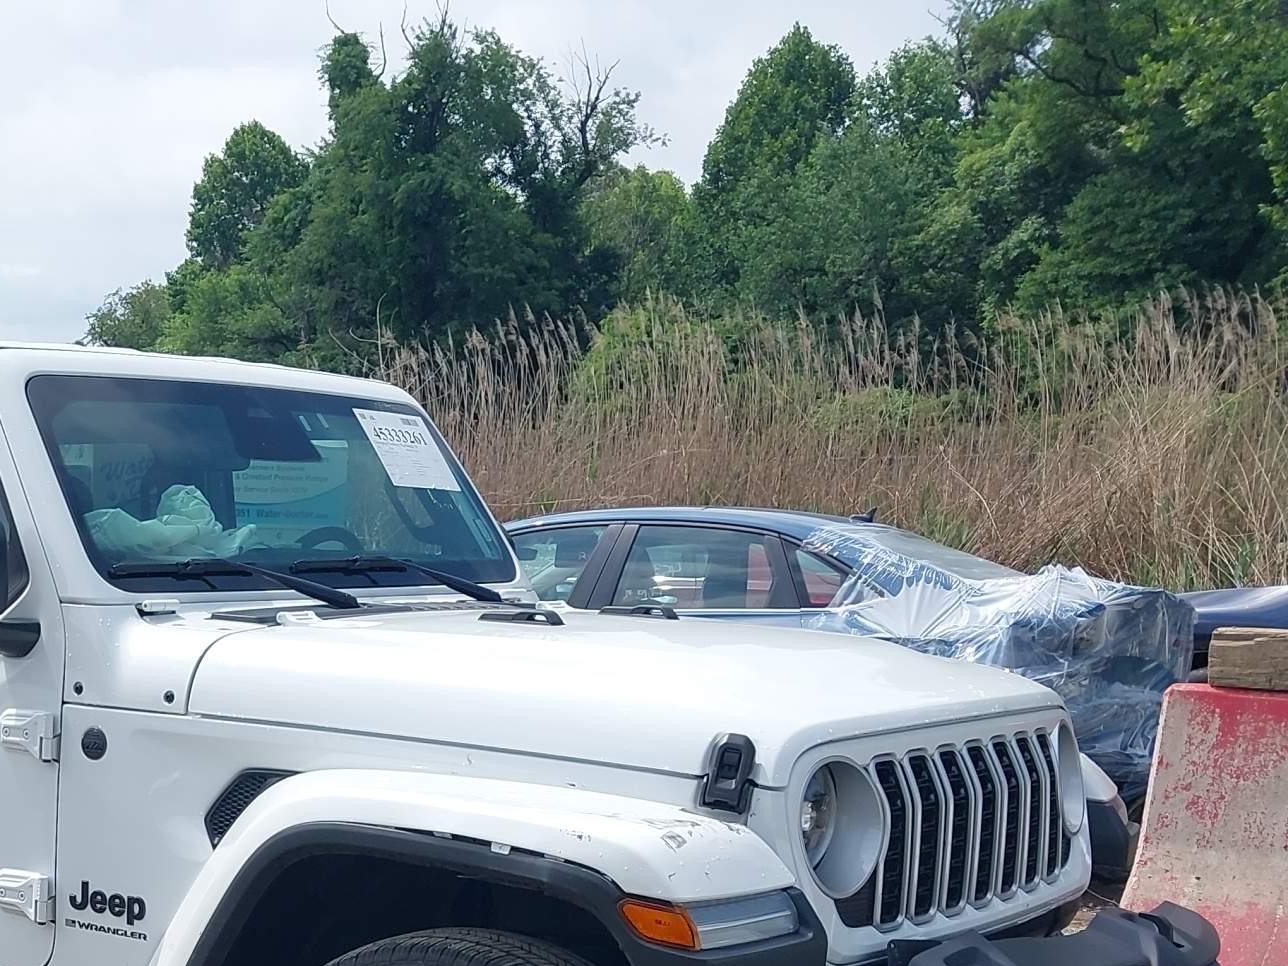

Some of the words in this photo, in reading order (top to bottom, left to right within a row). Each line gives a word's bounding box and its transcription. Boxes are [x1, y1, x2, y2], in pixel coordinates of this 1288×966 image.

[373, 425, 427, 446] 45333261
[69, 880, 146, 926] Jeep
[77, 920, 148, 941] WRANGLER
